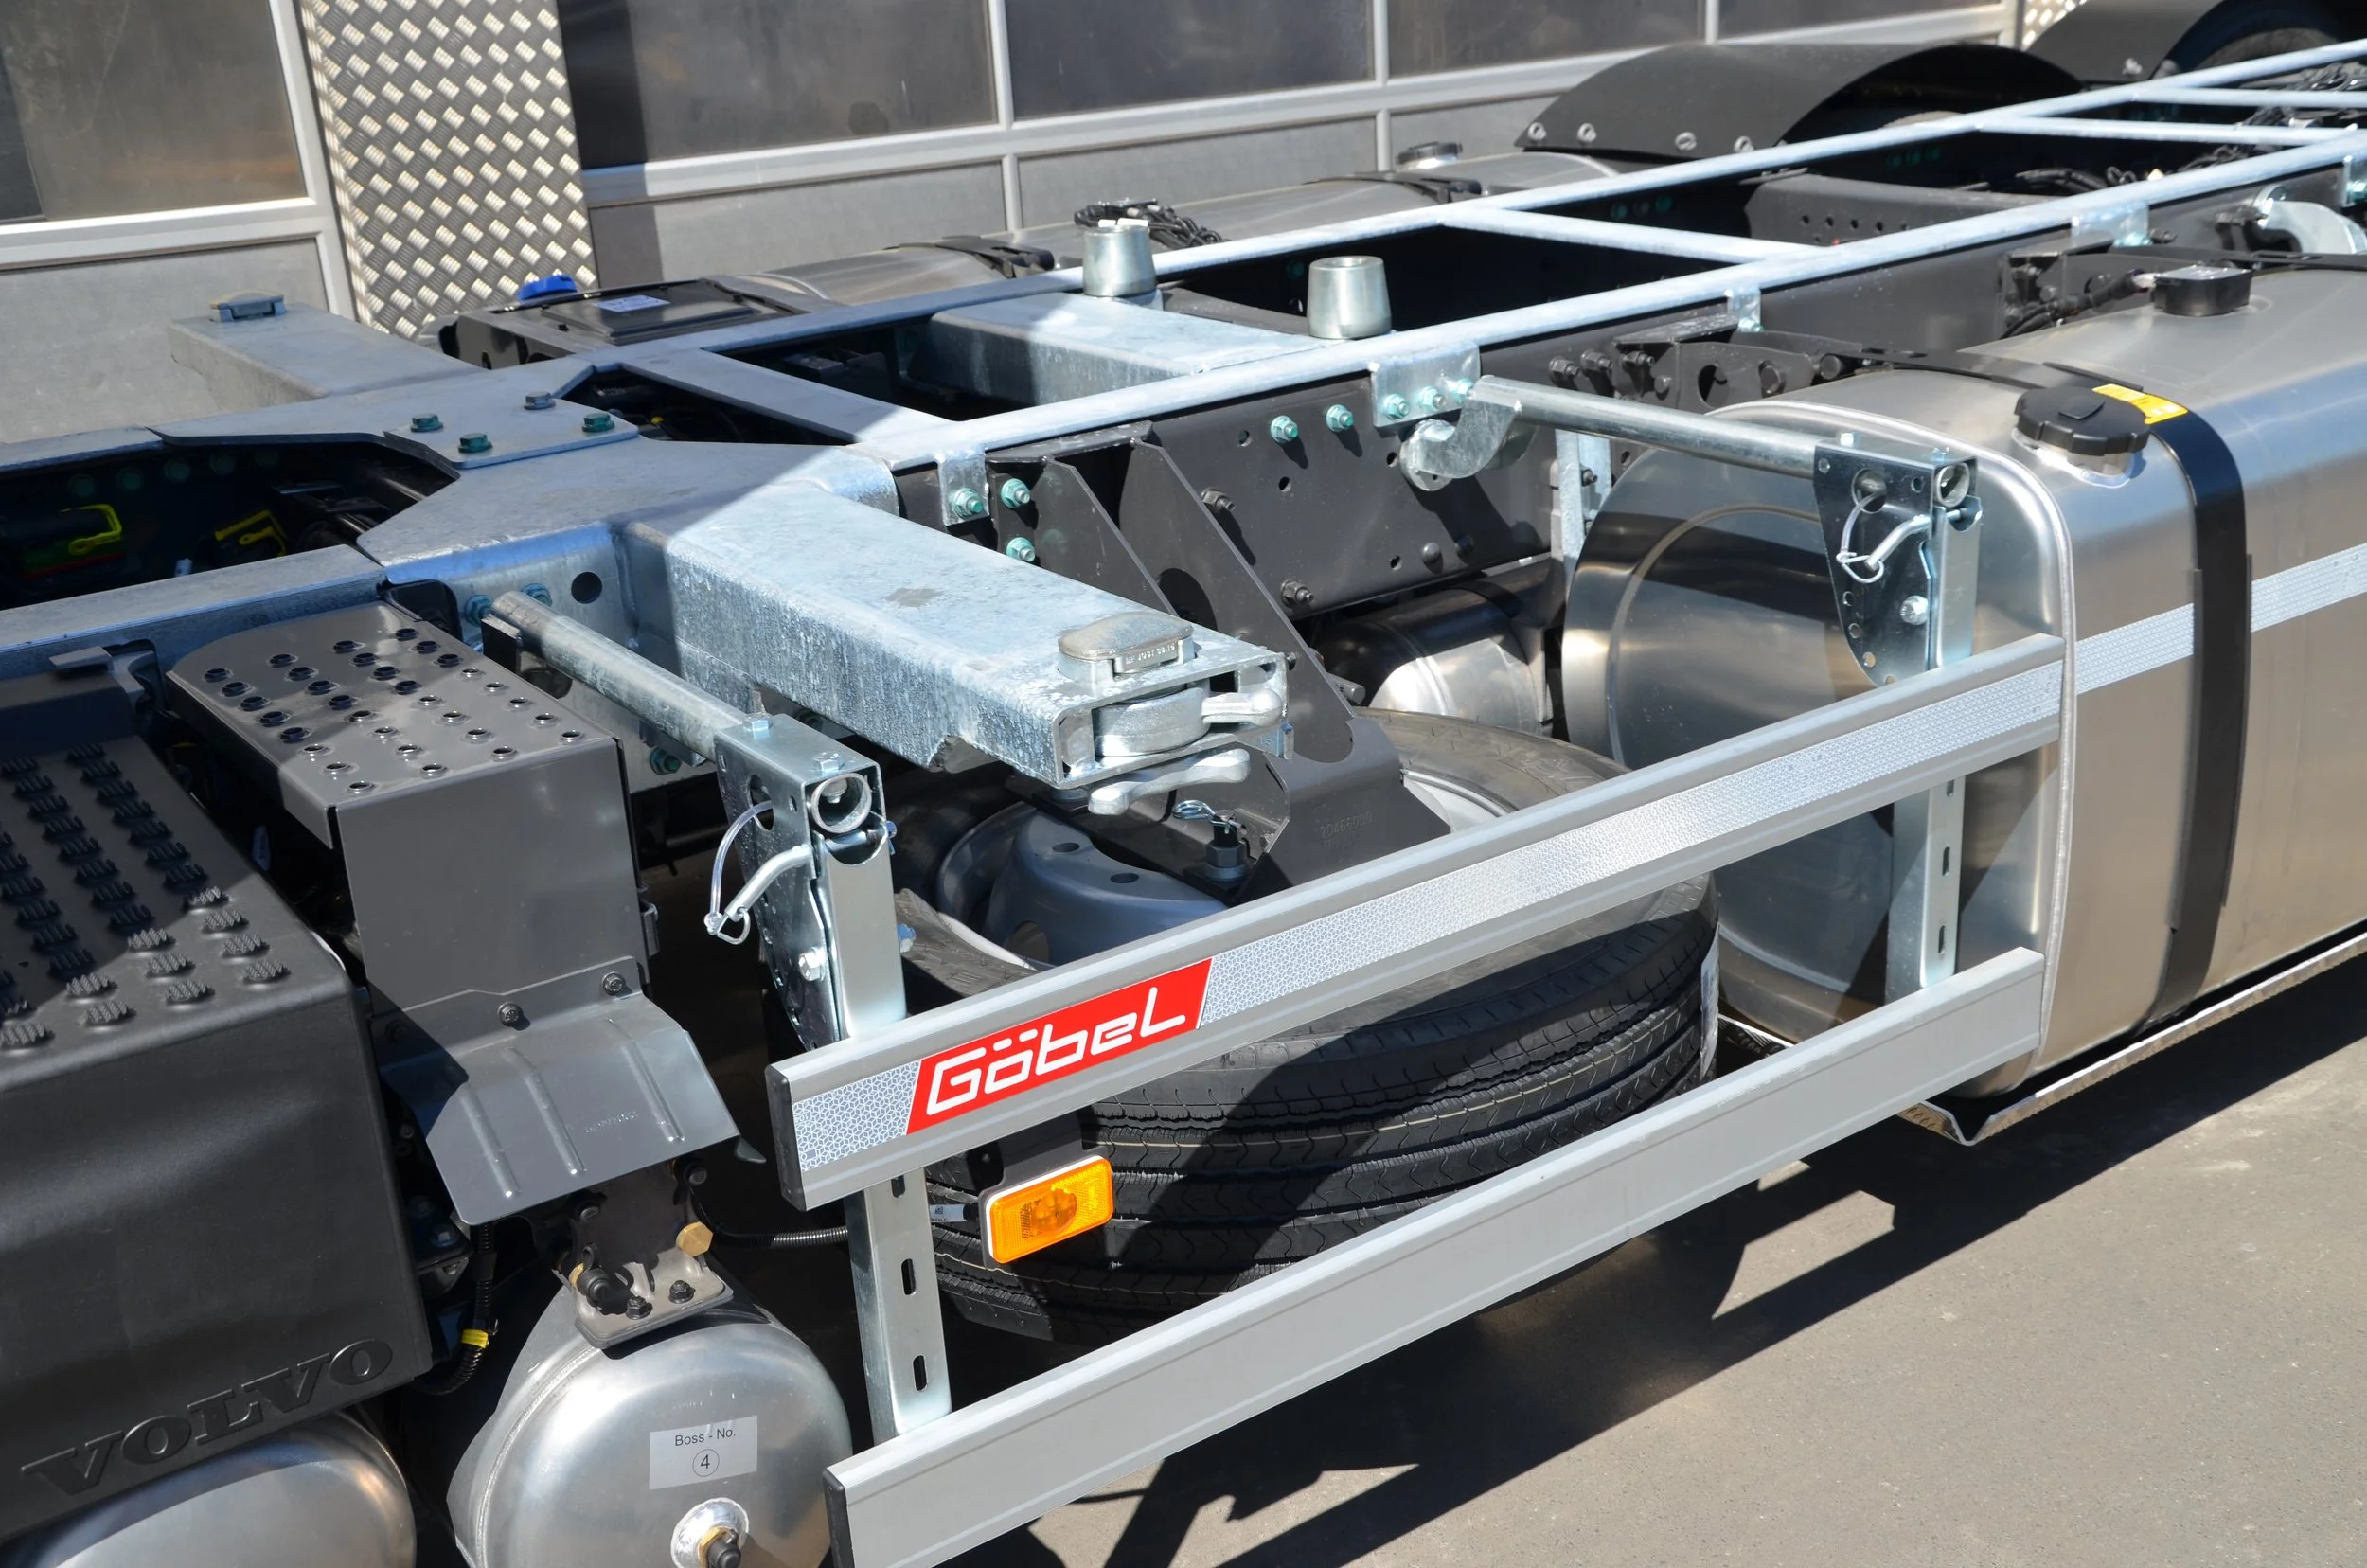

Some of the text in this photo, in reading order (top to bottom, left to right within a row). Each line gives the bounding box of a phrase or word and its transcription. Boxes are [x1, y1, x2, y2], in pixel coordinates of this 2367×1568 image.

[21, 1339, 393, 1496] VOLVO
[675, 1434, 705, 1447] Boss
[717, 1427, 737, 1440] No.
[701, 1453, 711, 1470] 4
